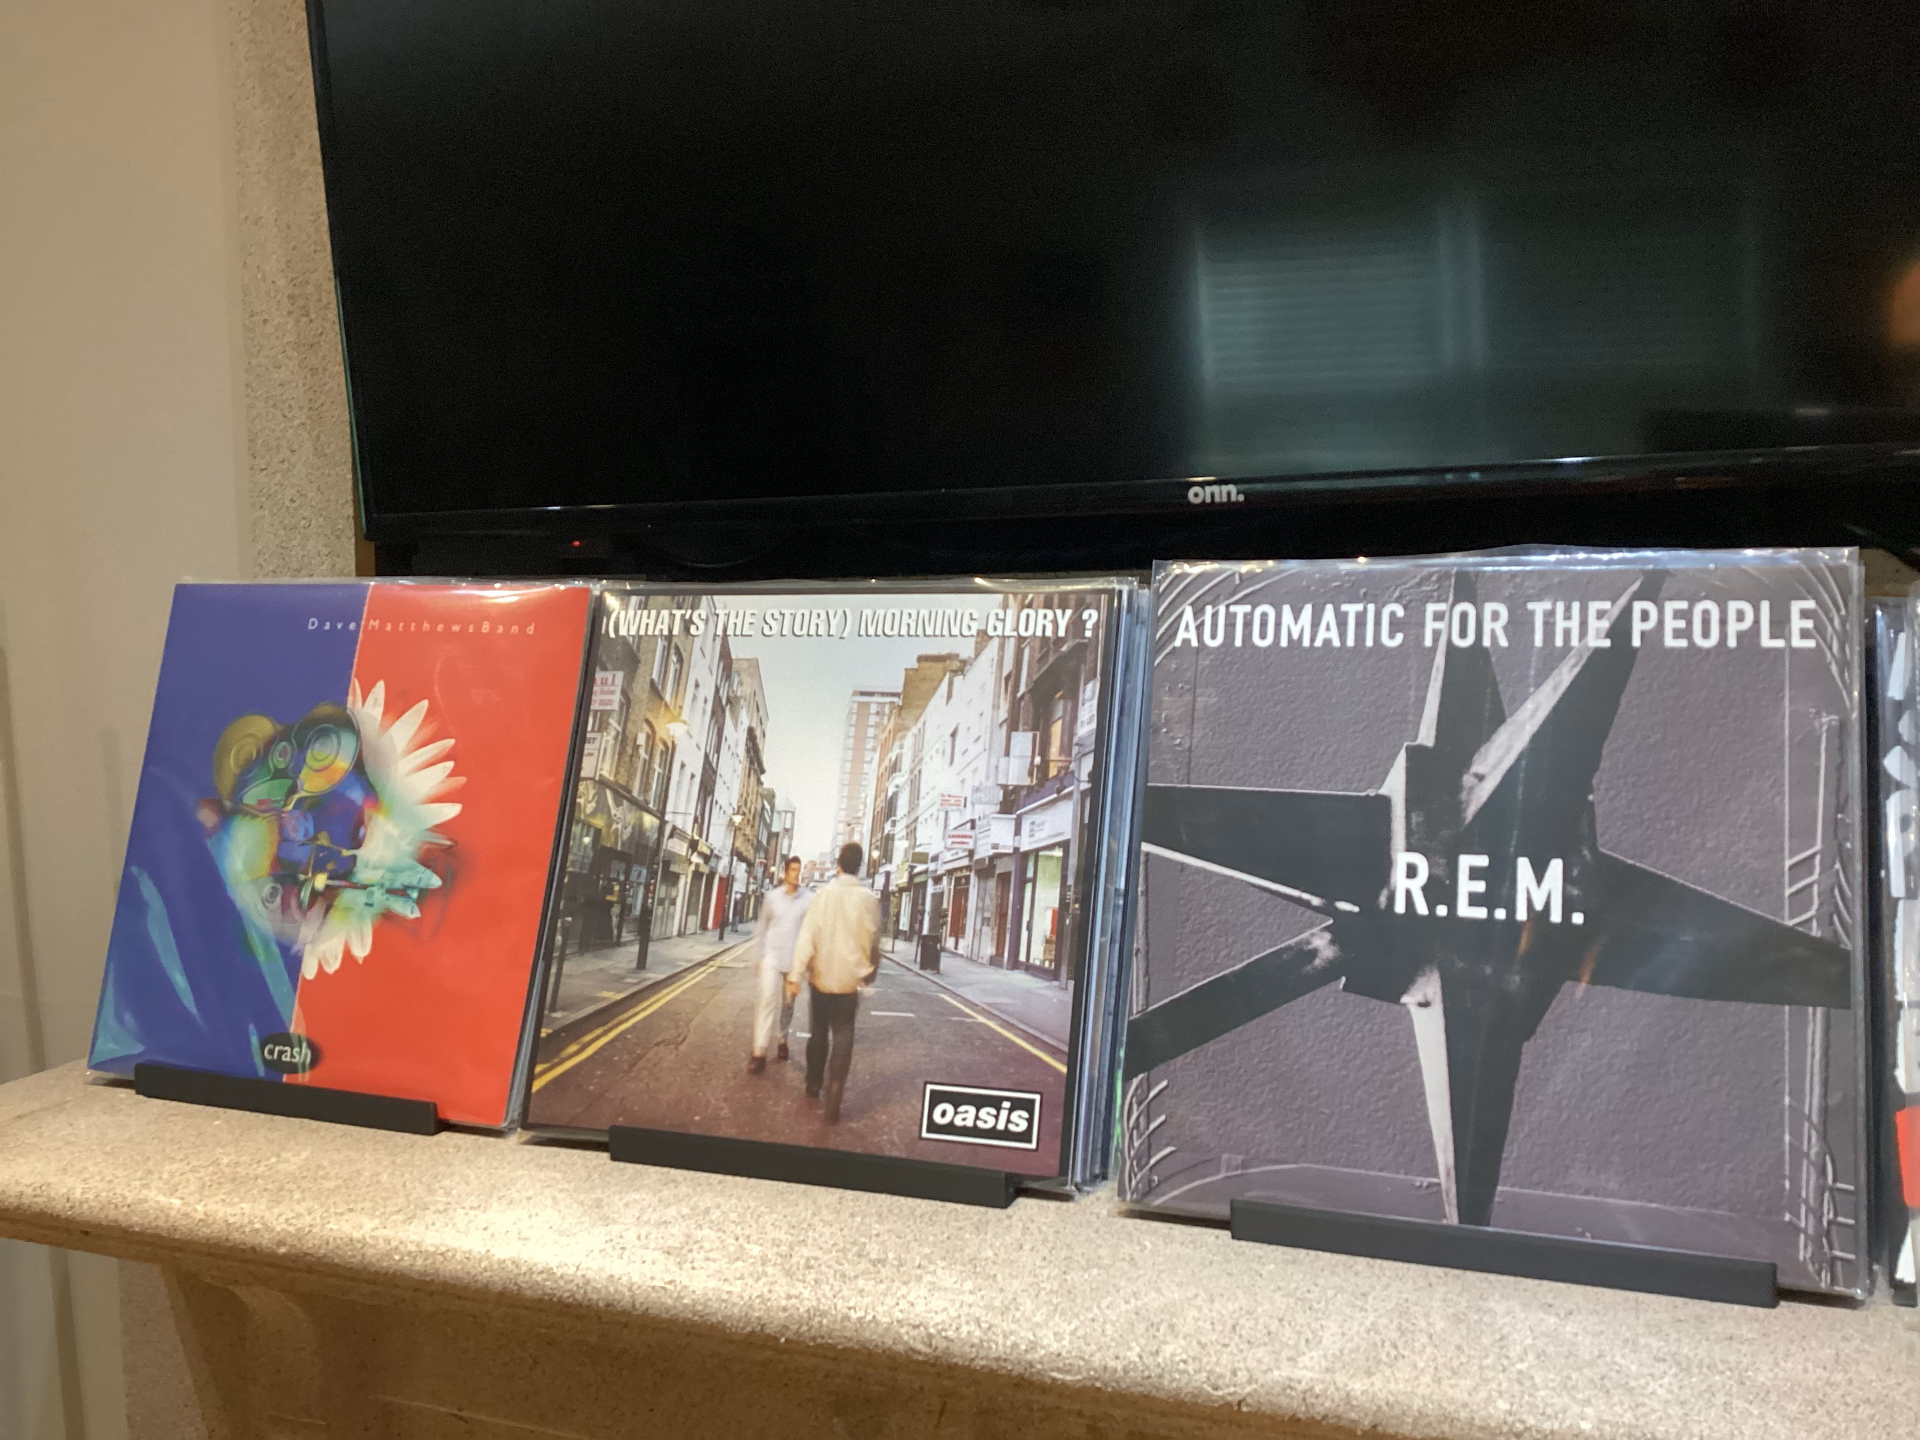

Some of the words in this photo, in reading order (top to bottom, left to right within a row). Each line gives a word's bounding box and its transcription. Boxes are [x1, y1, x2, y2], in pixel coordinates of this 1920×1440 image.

[1187, 484, 1245, 504] onn.
[307, 617, 357, 631] Dave
[608, 607, 707, 638] (WHAT'S
[712, 608, 760, 637] THE
[761, 608, 851, 639] STORY)
[857, 608, 979, 637] MORNING
[986, 608, 1073, 638] GLORY
[1081, 608, 1099, 637] ?
[1174, 602, 1405, 647] AUTOMATIC
[1424, 601, 1509, 647] FOR
[1527, 600, 1612, 648] THE
[1631, 599, 1817, 648] PEOPLE
[1393, 851, 1585, 925] R.E.M.
[264, 1041, 312, 1065] crash
[932, 1100, 1030, 1133] oasis
